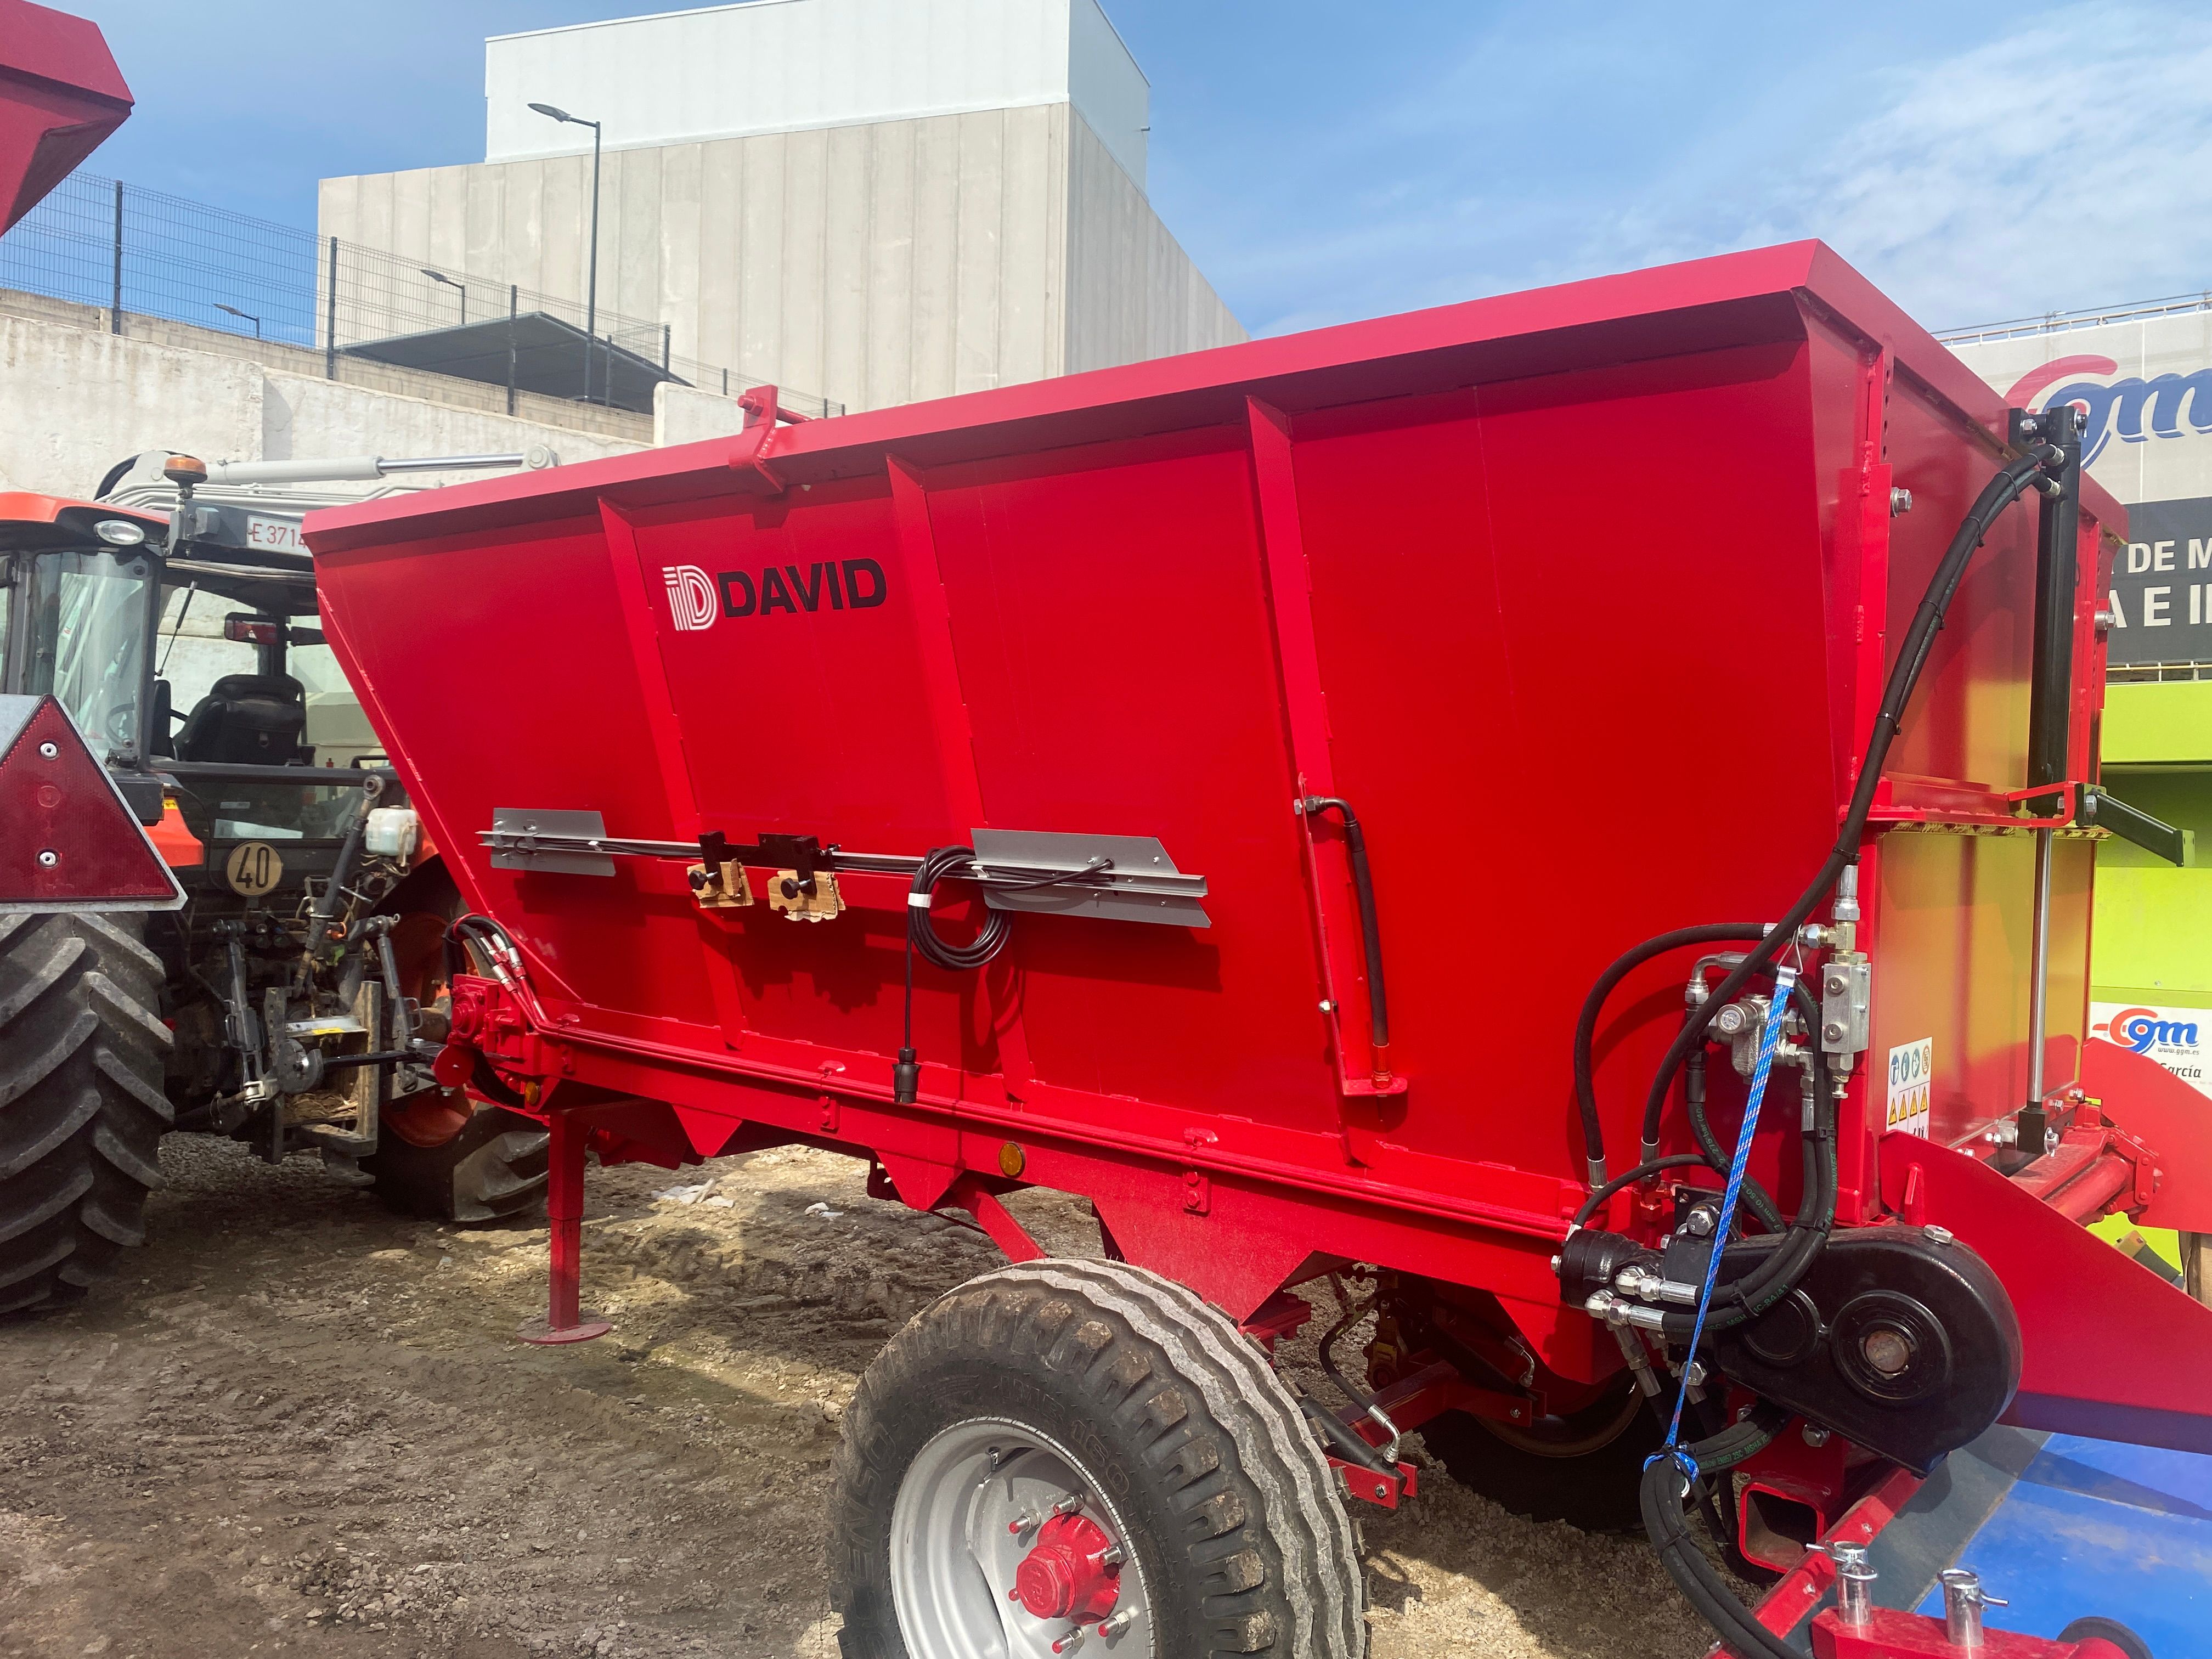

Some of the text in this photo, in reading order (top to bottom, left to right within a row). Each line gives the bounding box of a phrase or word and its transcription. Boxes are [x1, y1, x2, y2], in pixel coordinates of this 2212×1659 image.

[2128, 540, 2175, 573] DE
[716, 558, 887, 618] DAVID
[2144, 586, 2171, 627] E
[236, 847, 270, 888] 40
[2158, 1047, 2199, 1056] www.ggm.es
[2159, 1063, 2202, 1078] arcía
[1706, 1138, 1719, 1153] 275
[1726, 1314, 1748, 1326] MSH
